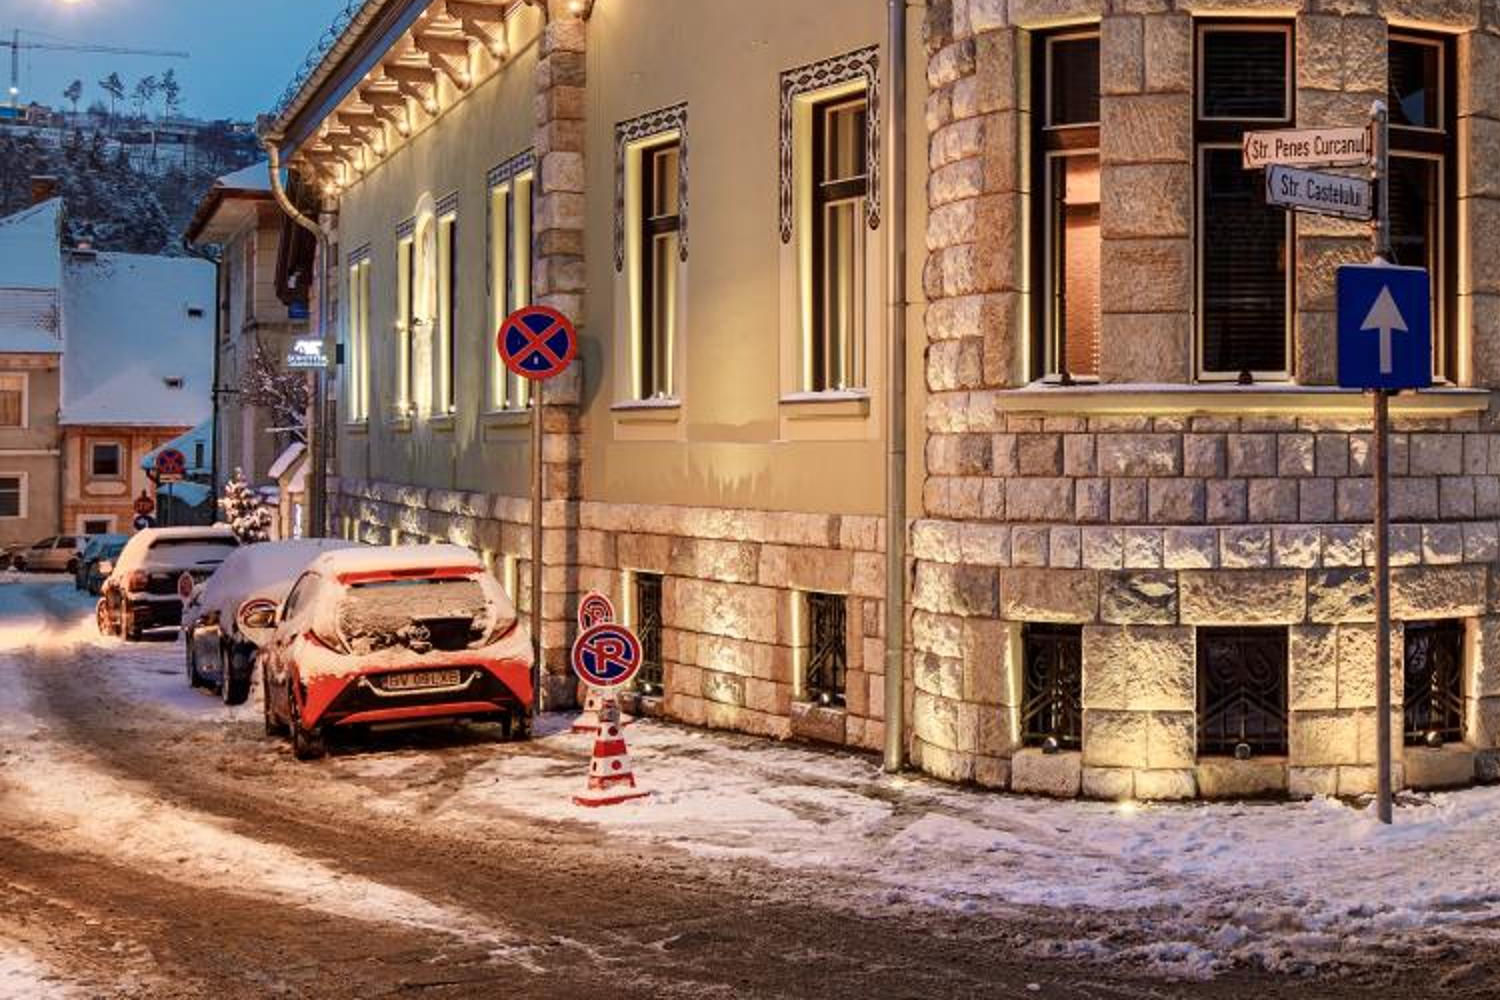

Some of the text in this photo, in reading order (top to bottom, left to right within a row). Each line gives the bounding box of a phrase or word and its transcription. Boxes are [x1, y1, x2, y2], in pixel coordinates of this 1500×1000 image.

[1252, 140, 1271, 159] Str.
[1275, 138, 1309, 158] Penes
[1281, 174, 1302, 197] Str.
